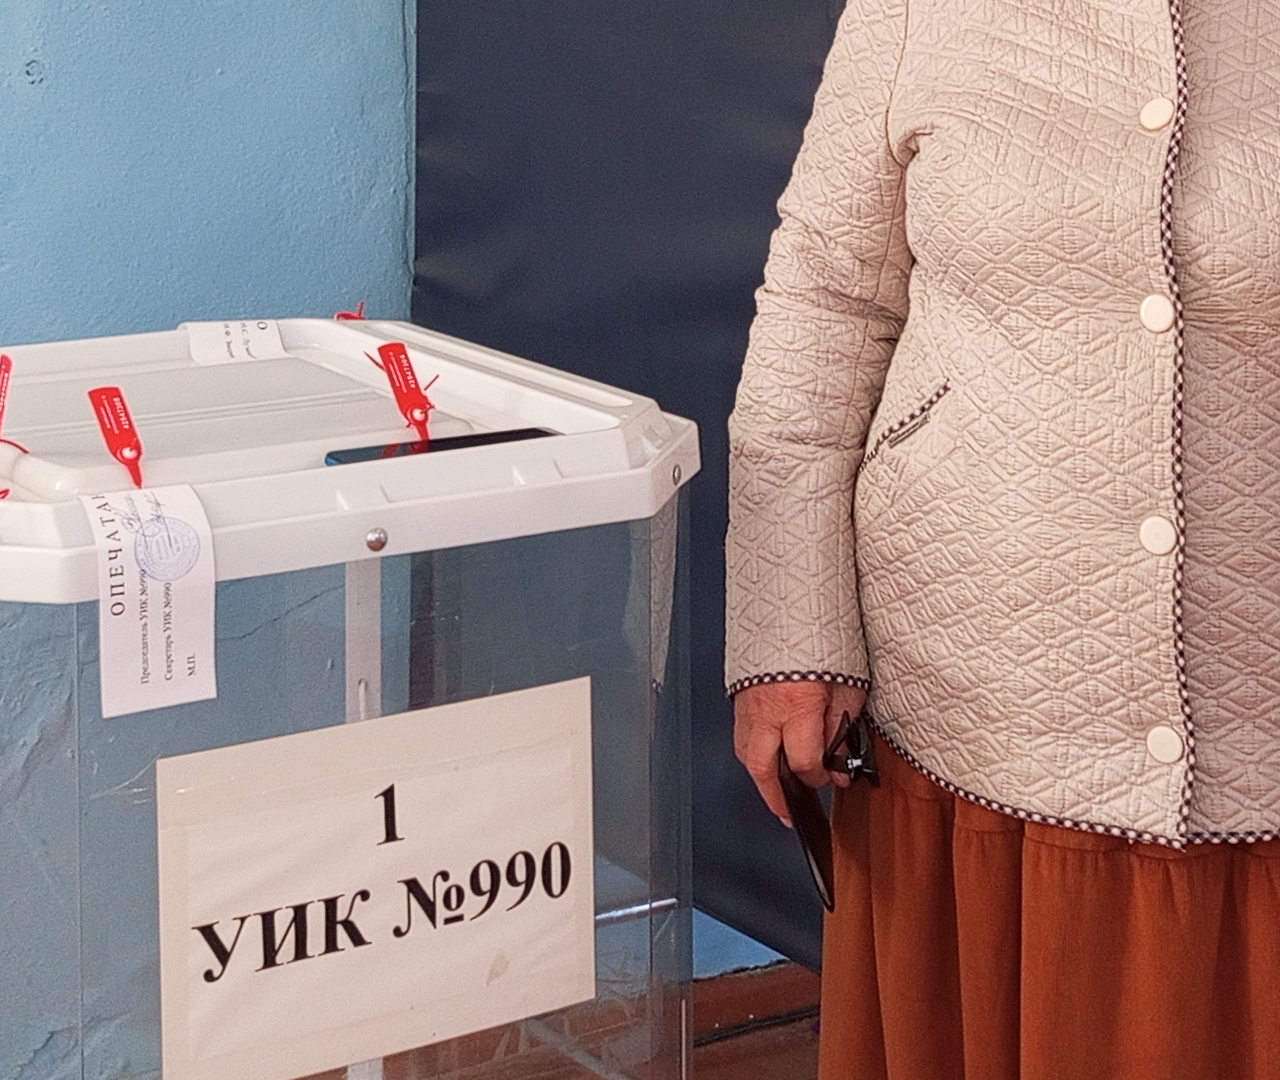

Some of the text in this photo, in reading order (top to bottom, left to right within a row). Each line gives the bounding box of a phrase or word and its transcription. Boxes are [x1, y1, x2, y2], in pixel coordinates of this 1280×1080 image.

[139, 597, 149, 621] УИК
[163, 582, 174, 681] Секретарь УИК №990
[140, 622, 151, 684] Председатель
[374, 783, 405, 846] 1
[191, 842, 571, 983] УИК №990
